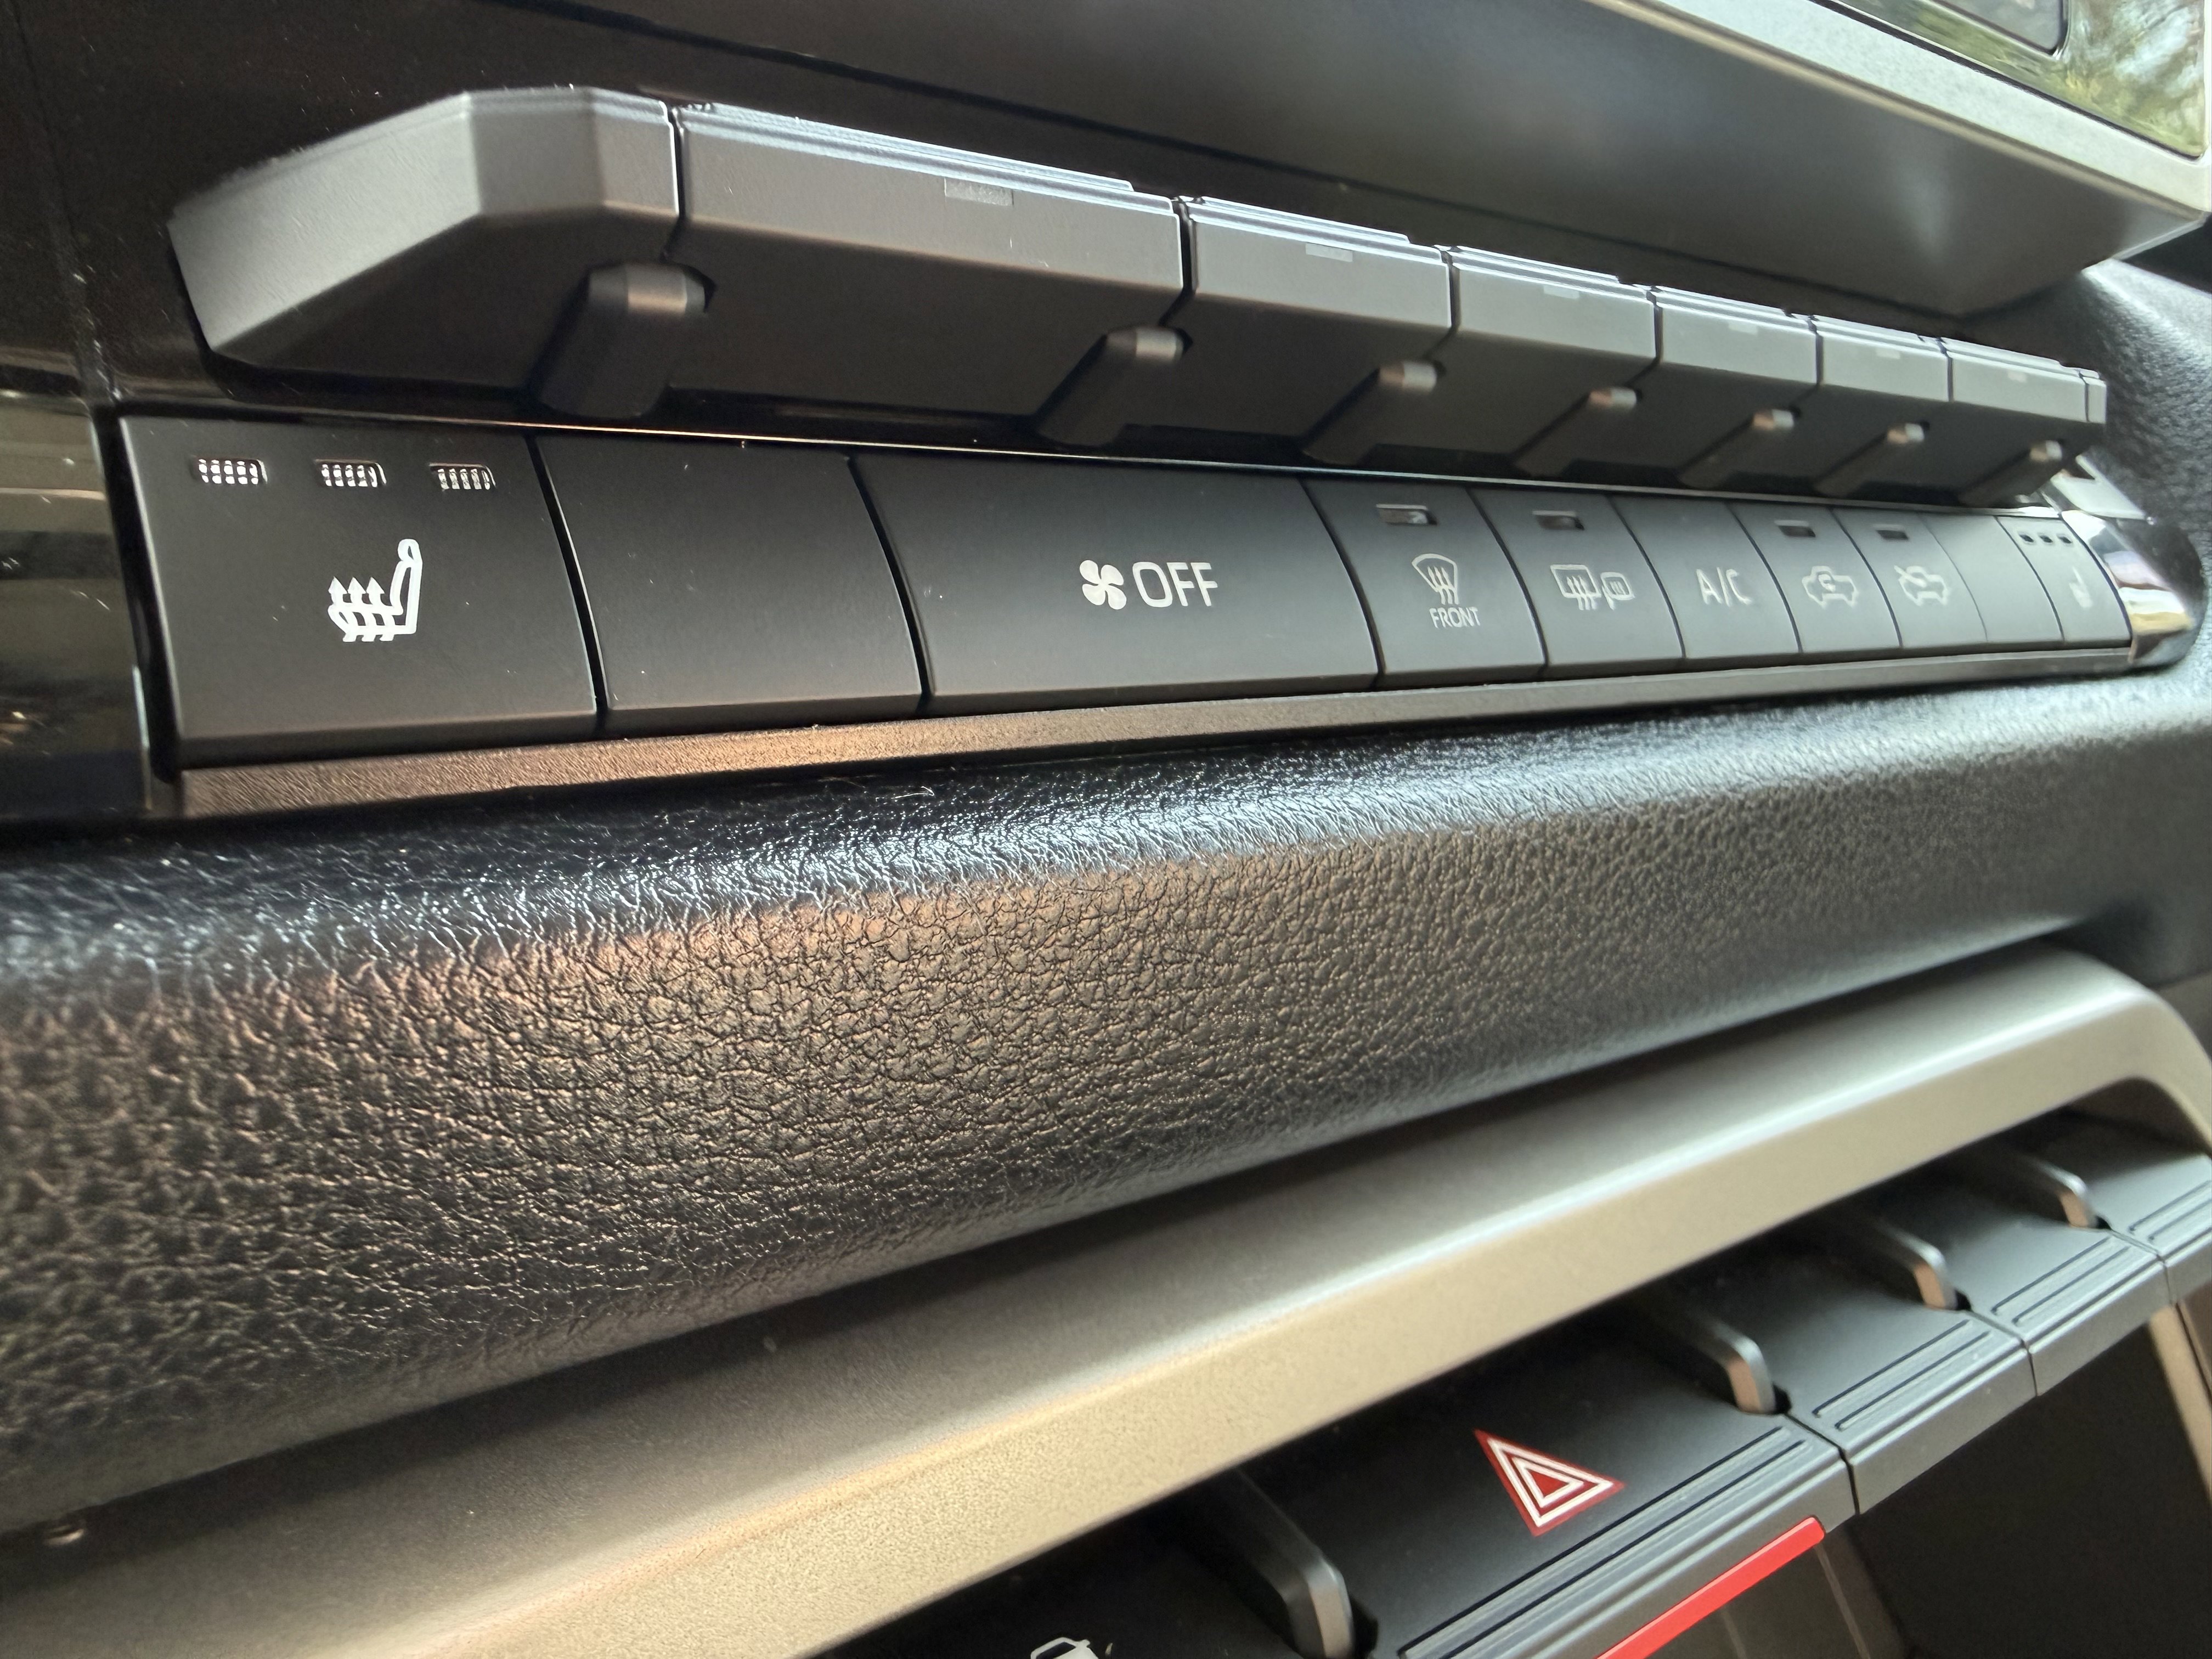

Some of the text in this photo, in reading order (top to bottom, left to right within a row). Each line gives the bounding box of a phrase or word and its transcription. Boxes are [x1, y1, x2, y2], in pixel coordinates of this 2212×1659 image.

[1132, 561, 1218, 608] OFF
[1696, 566, 1753, 607] A/C
[1429, 606, 1481, 628] FRONT
